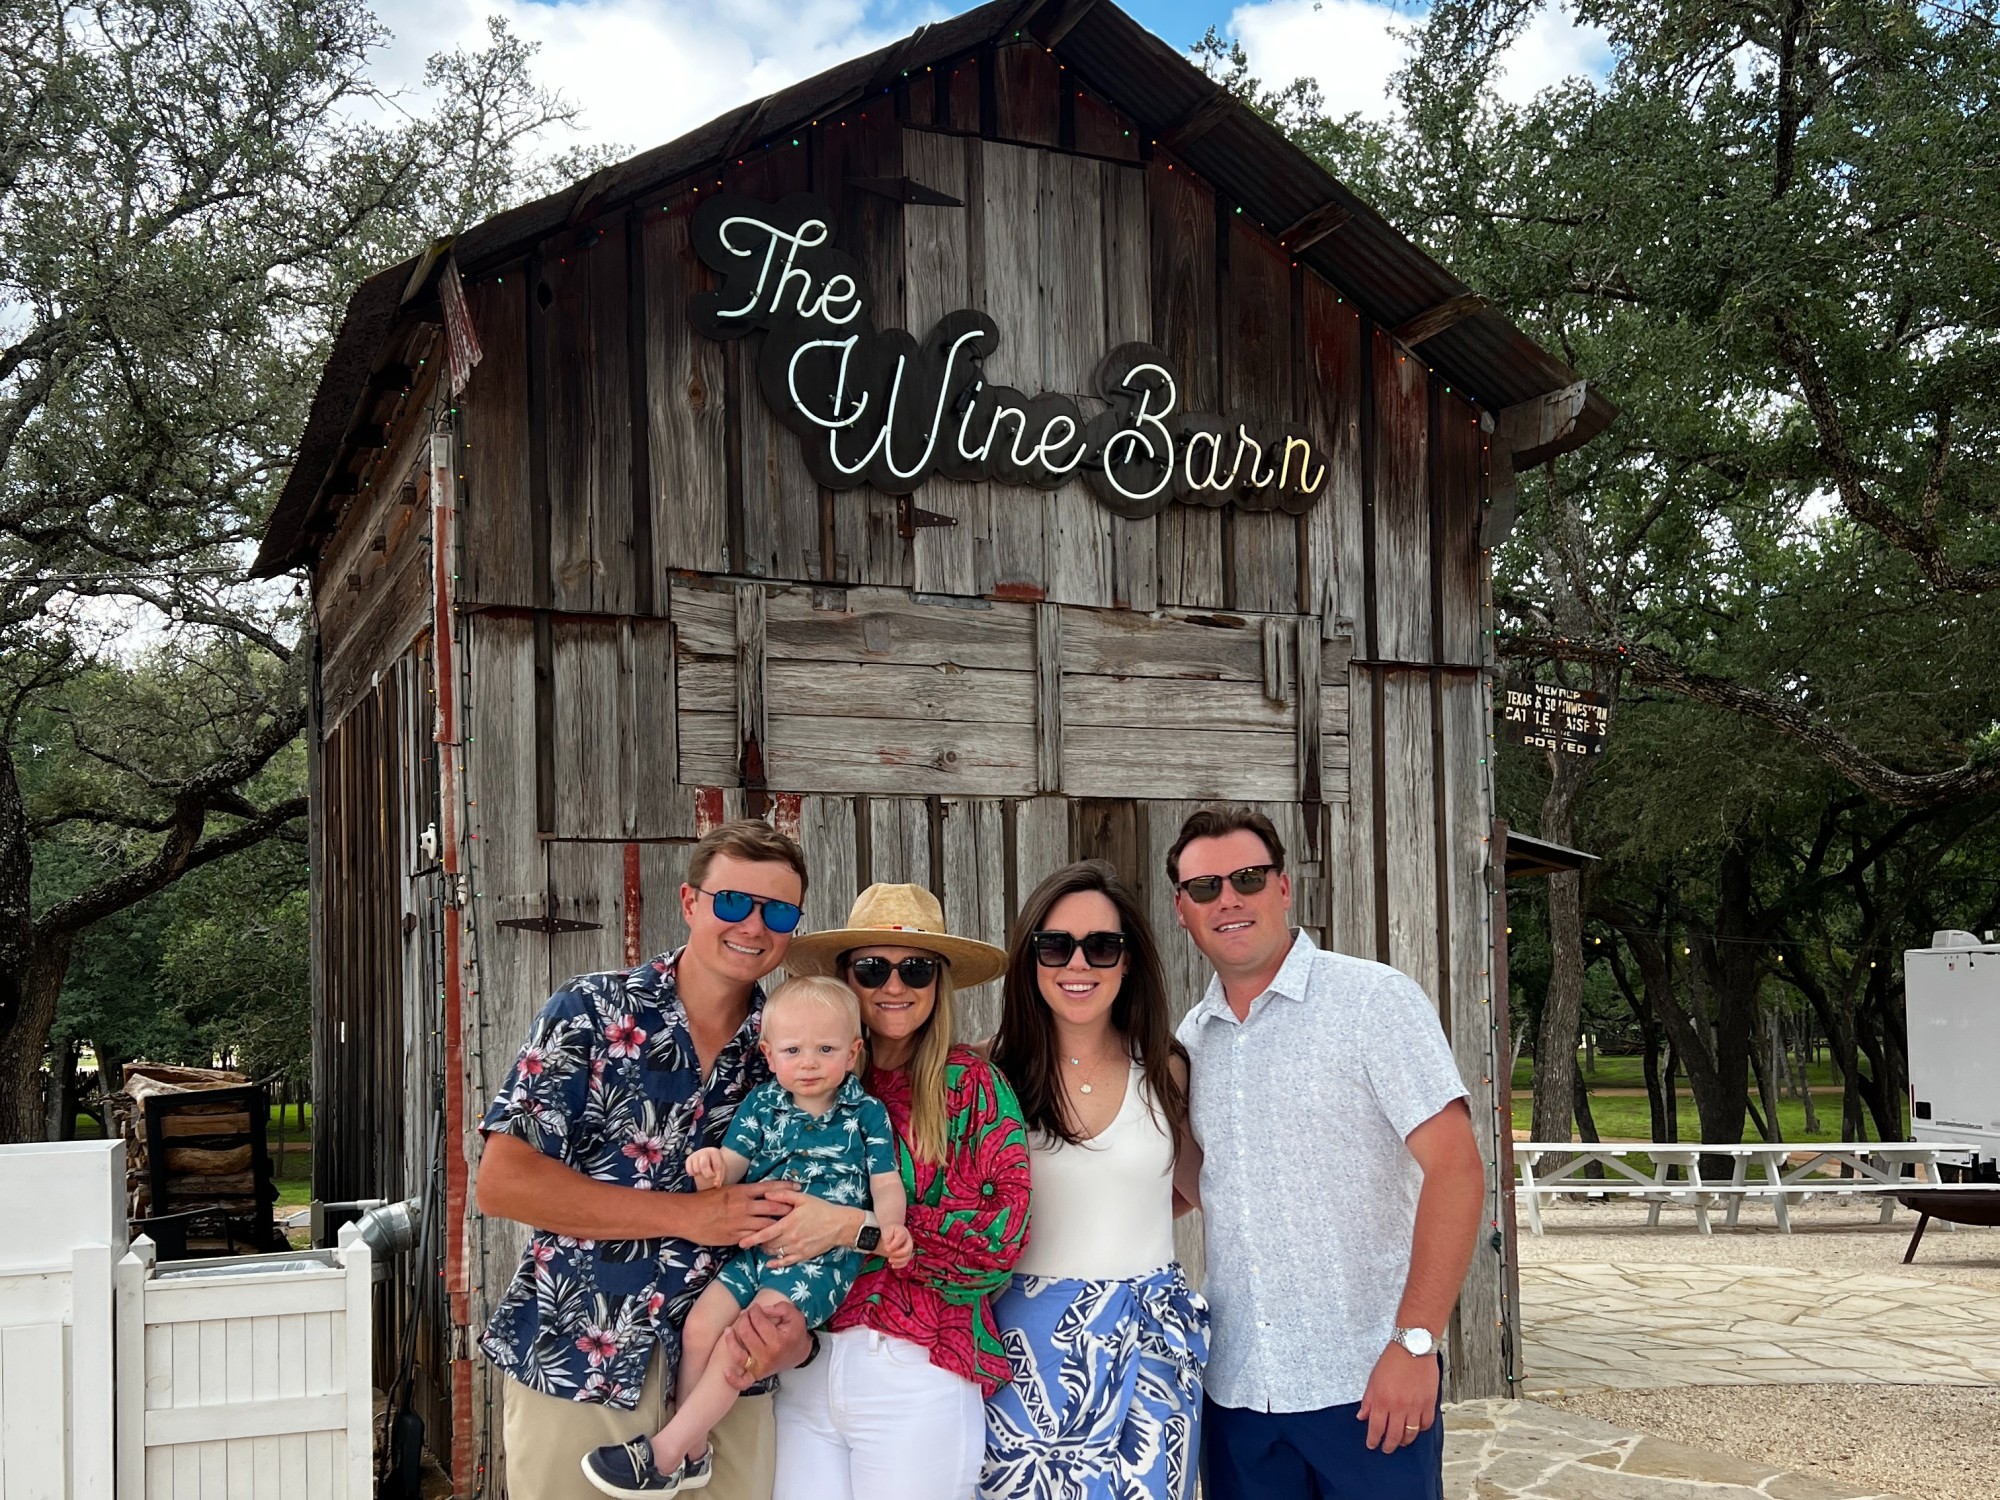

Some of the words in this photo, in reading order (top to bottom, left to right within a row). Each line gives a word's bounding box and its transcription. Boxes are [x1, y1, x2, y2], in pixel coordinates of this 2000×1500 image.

[716, 215, 863, 325] The
[787, 329, 1087, 479] Wine
[1103, 363, 1327, 500] Barn
[1505, 706, 1551, 726] CATLE
[1558, 714, 1607, 736] AISES
[1506, 690, 1532, 706] TEXAS
[1534, 695, 1542, 709] &
[1545, 697, 1608, 721] SOTHWESTRN
